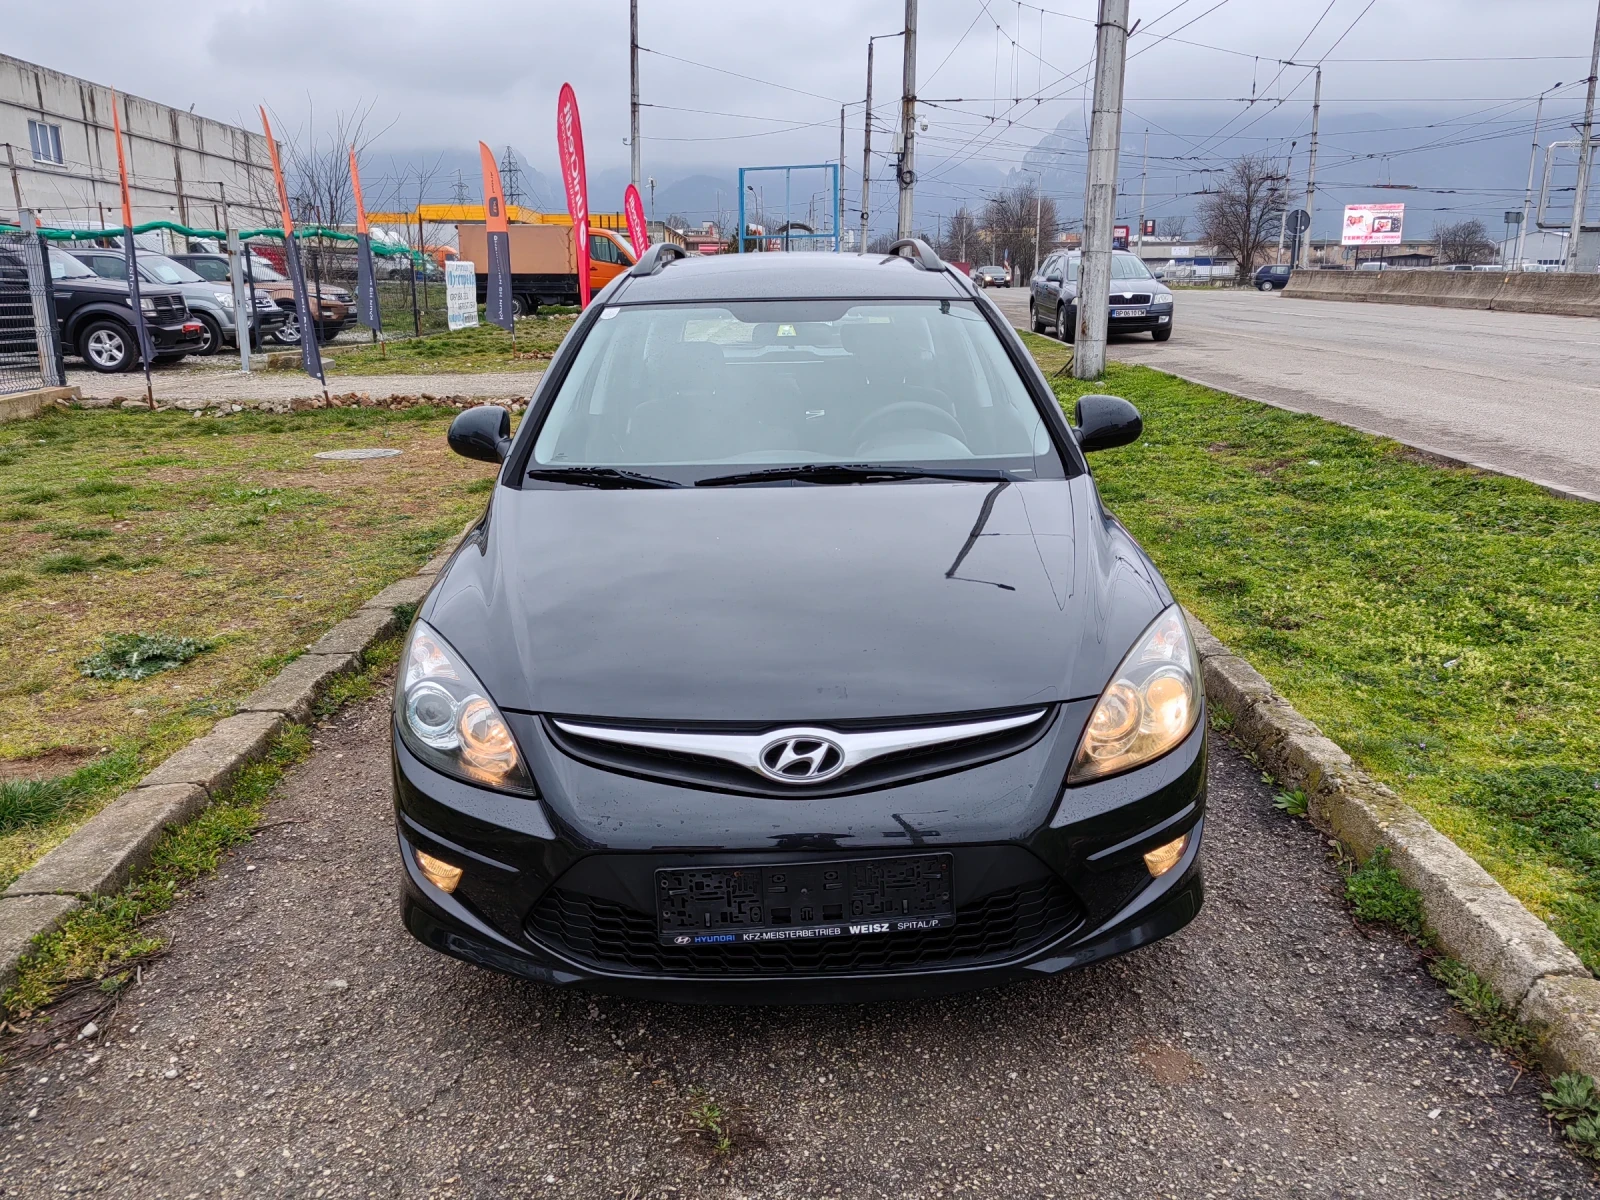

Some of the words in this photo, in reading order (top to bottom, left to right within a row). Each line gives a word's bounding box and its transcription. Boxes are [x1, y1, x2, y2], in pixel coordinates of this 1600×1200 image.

[694, 934, 736, 943] HYUNDAI
[743, 927, 841, 941] KFZ-MEISTERBETRIEB
[849, 923, 890, 934] WEISZ
